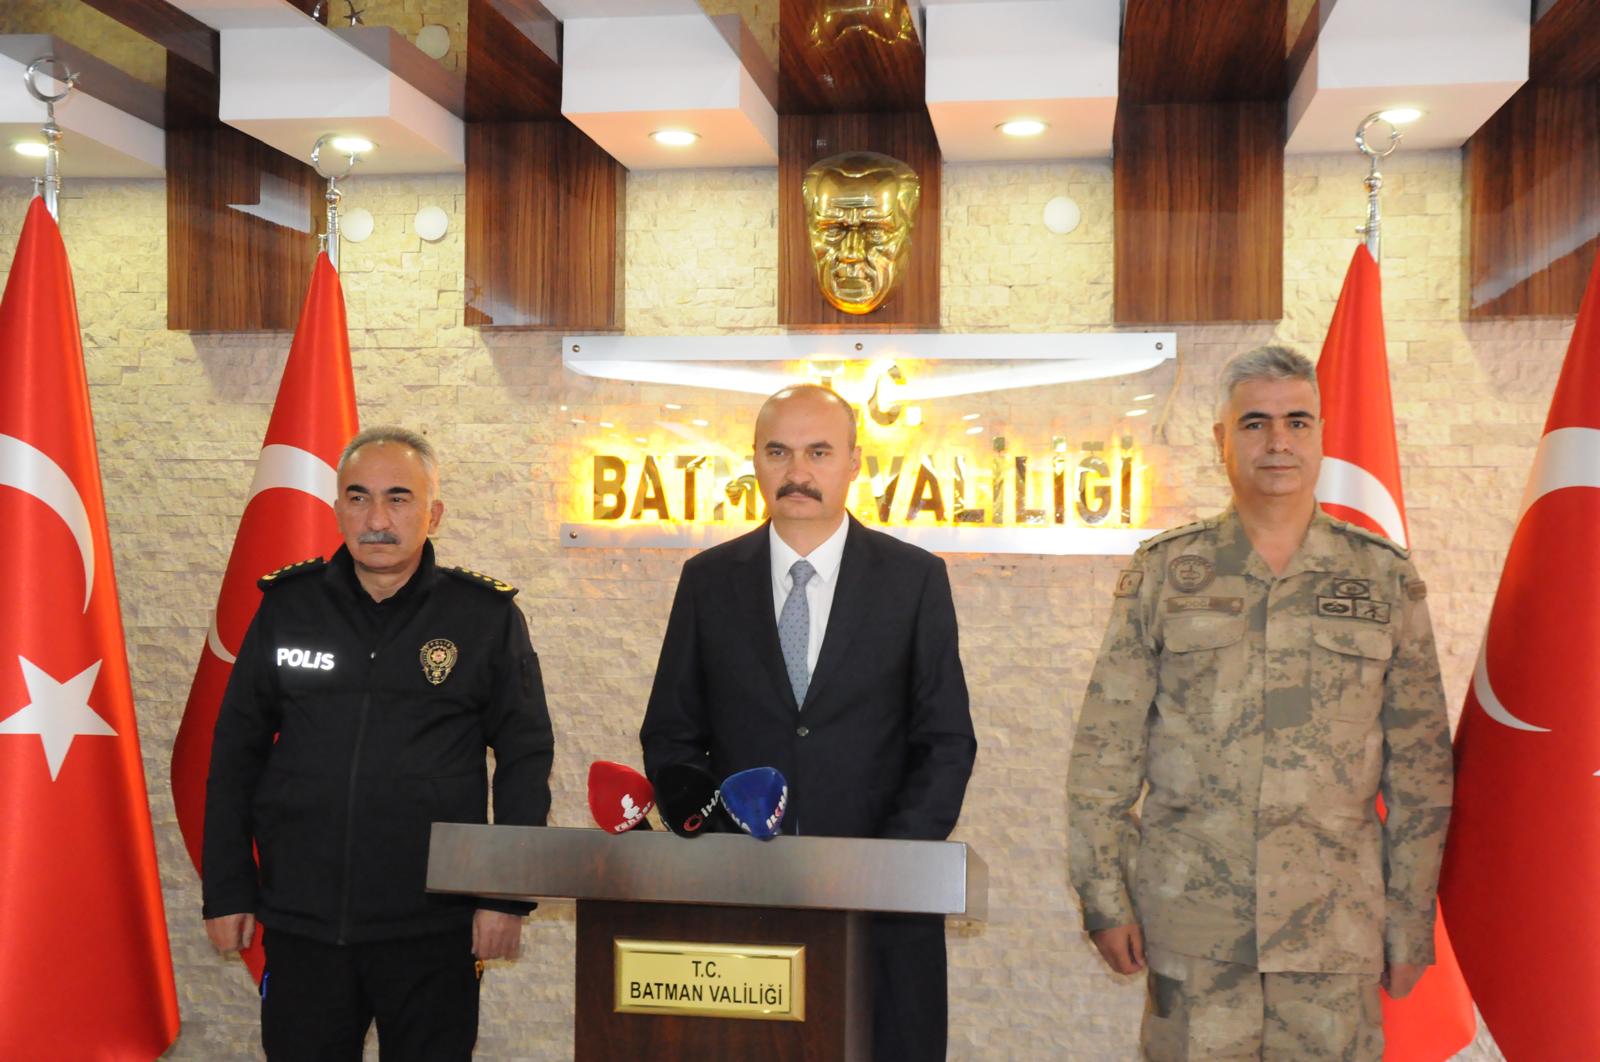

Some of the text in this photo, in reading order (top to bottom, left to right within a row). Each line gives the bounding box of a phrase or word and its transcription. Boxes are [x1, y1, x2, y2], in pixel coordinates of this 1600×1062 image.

[865, 435, 1134, 525] VALİLİĞİ
[692, 960, 722, 979] T.C.
[630, 981, 783, 1006] BATMAN VALİLİĞİ
